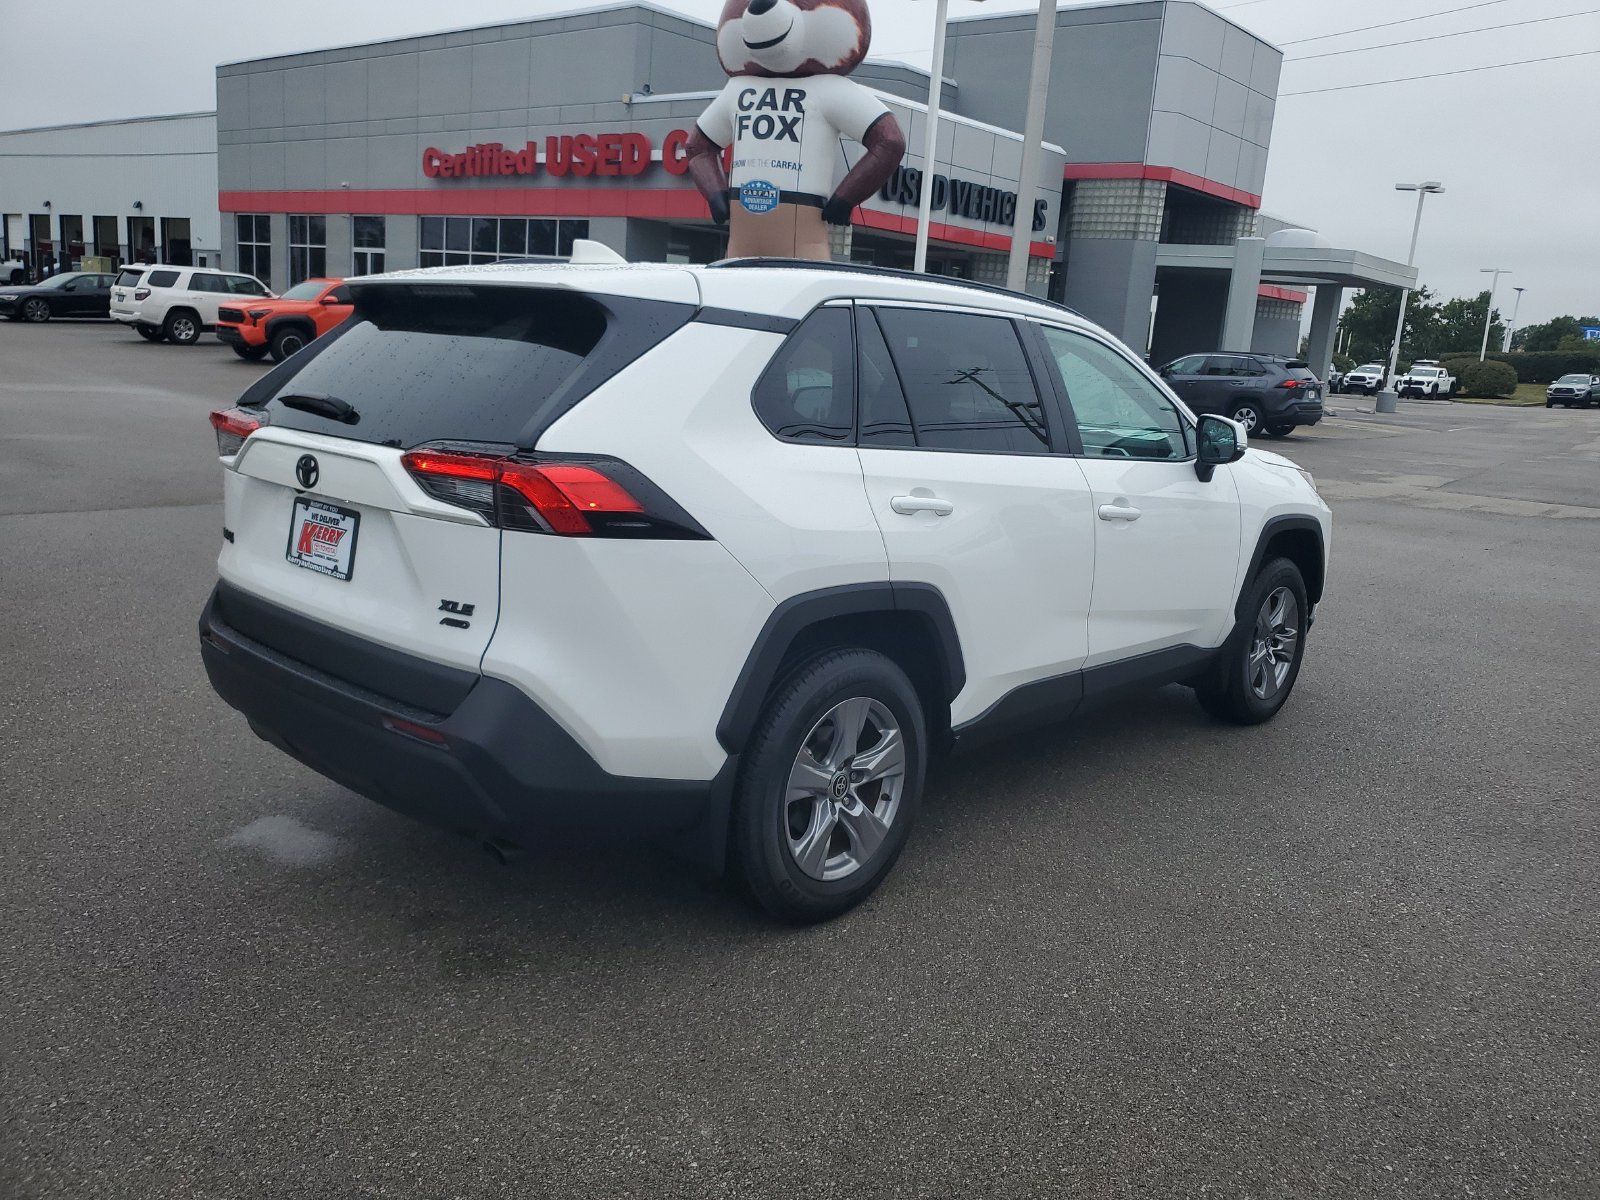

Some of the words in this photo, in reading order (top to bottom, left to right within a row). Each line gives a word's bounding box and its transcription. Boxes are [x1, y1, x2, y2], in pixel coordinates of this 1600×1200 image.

[738, 88, 807, 112] CAR
[737, 114, 802, 142] FOX
[422, 140, 537, 178] Certified
[545, 131, 652, 177] USED
[771, 159, 803, 172] CARFAX
[743, 189, 776, 198] CARFAX
[744, 197, 773, 205] ADVANTAGE
[881, 165, 949, 211] USD
[949, 178, 1048, 232] VEHICS
[311, 512, 319, 521] WE
[319, 514, 340, 526] DELIVER
[297, 521, 344, 554] KERRY
[320, 544, 336, 553] TOYOTA
[287, 555, 346, 580] kerryautomotive.com
[438, 599, 475, 616] XLE
